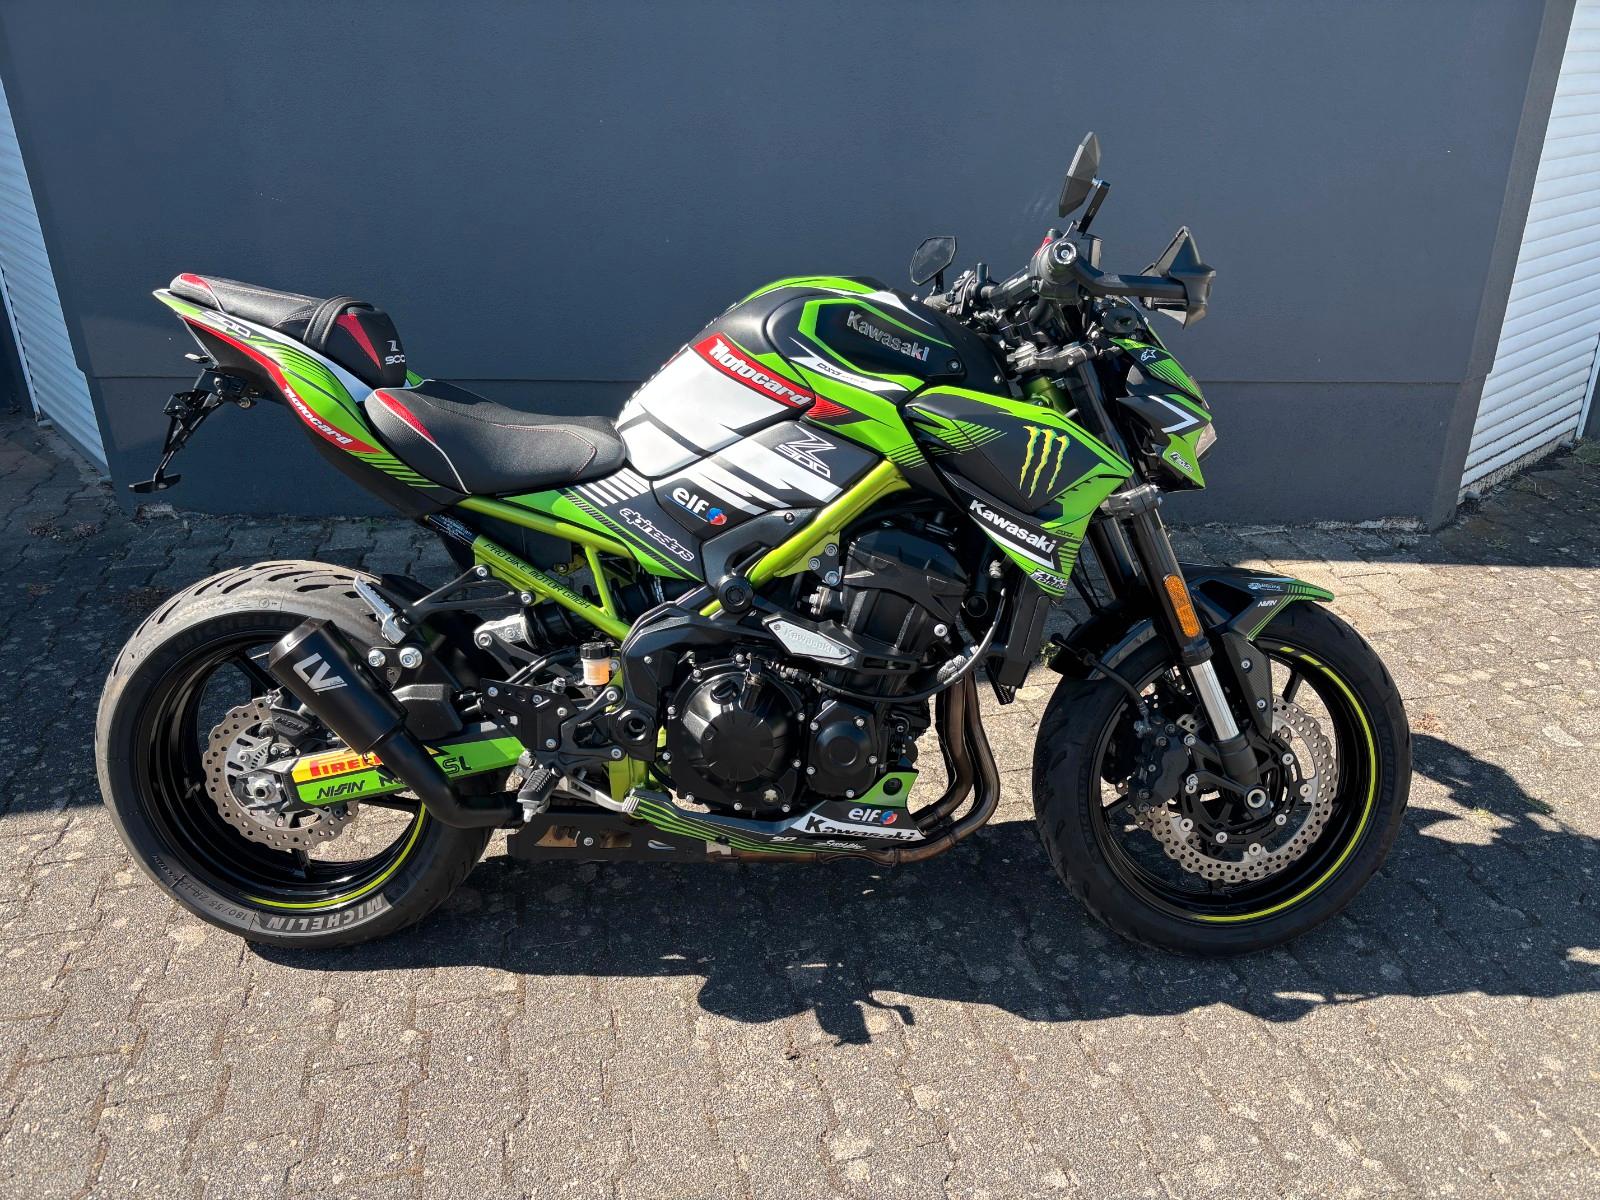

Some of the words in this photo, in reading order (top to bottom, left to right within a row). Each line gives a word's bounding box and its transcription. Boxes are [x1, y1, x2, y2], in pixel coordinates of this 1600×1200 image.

[846, 310, 930, 362] Kawasaki
[708, 338, 812, 405] Motocard
[284, 384, 354, 444] Motocard
[775, 443, 831, 479] 900
[672, 487, 710, 515] elf
[969, 499, 1057, 553] Kawasaki
[484, 543, 507, 559] PRO
[505, 556, 526, 573] BIKE
[528, 570, 564, 593] MOTOR
[292, 652, 346, 692] LV
[309, 752, 384, 777] PIRE
[804, 815, 915, 841] Kawasaki
[848, 807, 879, 822] elf
[266, 892, 385, 931] MICHELIN
